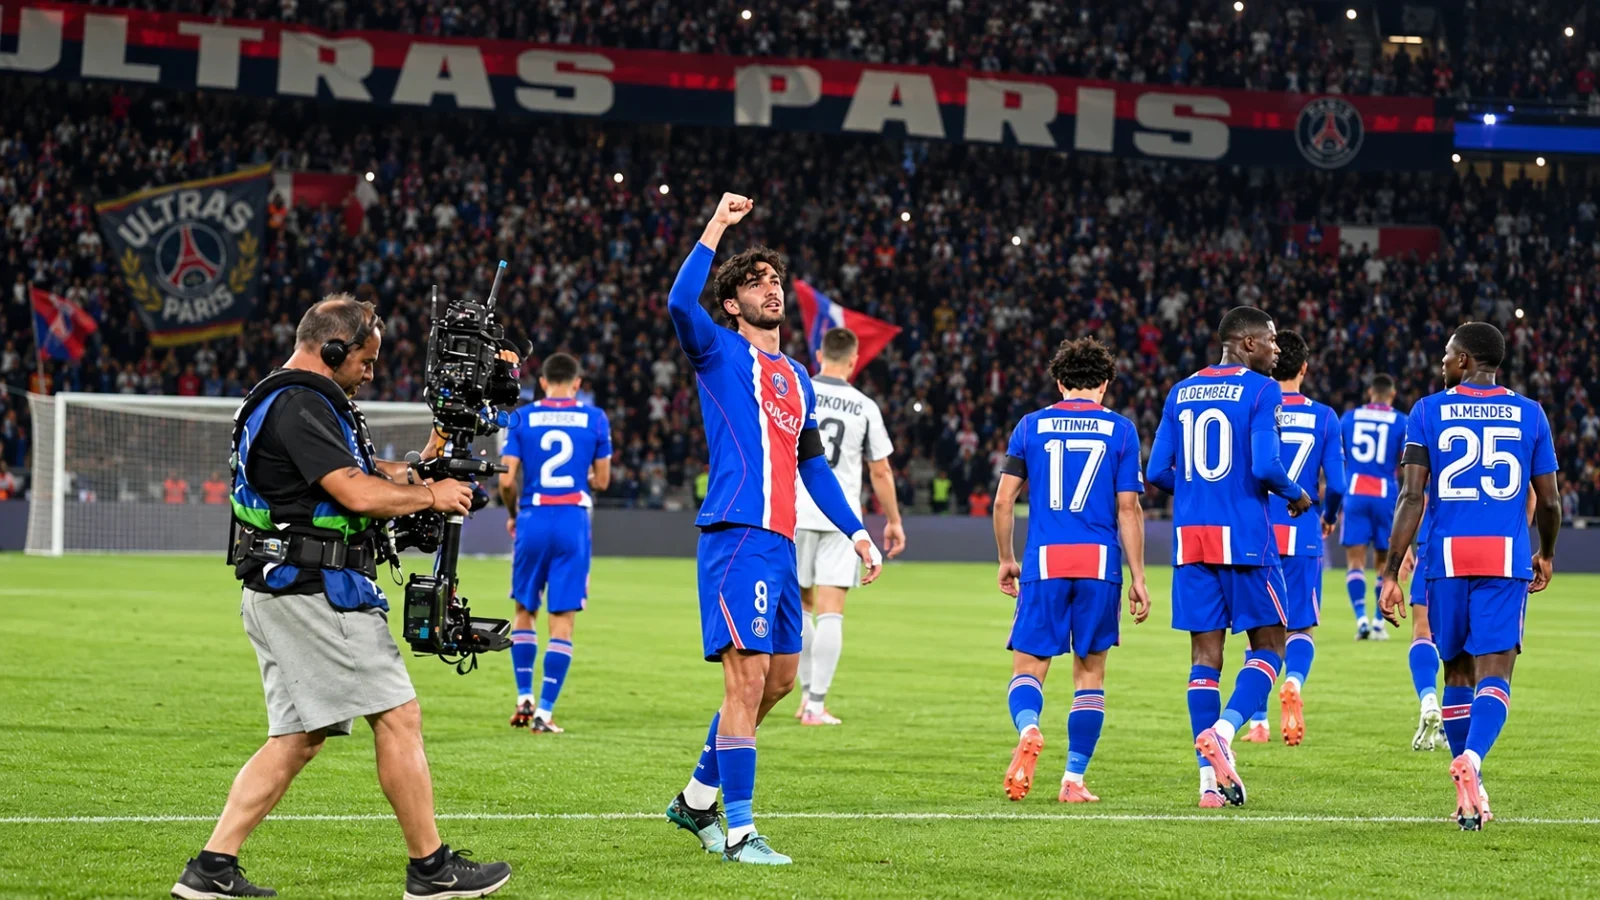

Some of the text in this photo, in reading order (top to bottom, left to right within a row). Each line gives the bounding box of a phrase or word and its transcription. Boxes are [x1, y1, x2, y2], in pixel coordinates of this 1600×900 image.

[0, 8, 1230, 160] ULTRAS PARIS
[118, 189, 253, 247] ULTRAS
[162, 284, 234, 324] PARIS
[1051, 419, 1099, 432] VITINHA
[1450, 405, 1512, 418] N.MENDES
[540, 430, 575, 488] 2
[1179, 408, 1232, 482] 10
[1351, 421, 1389, 464] 51
[1438, 426, 1522, 501] 25
[1044, 439, 1106, 512] 17
[754, 580, 768, 614] 8
